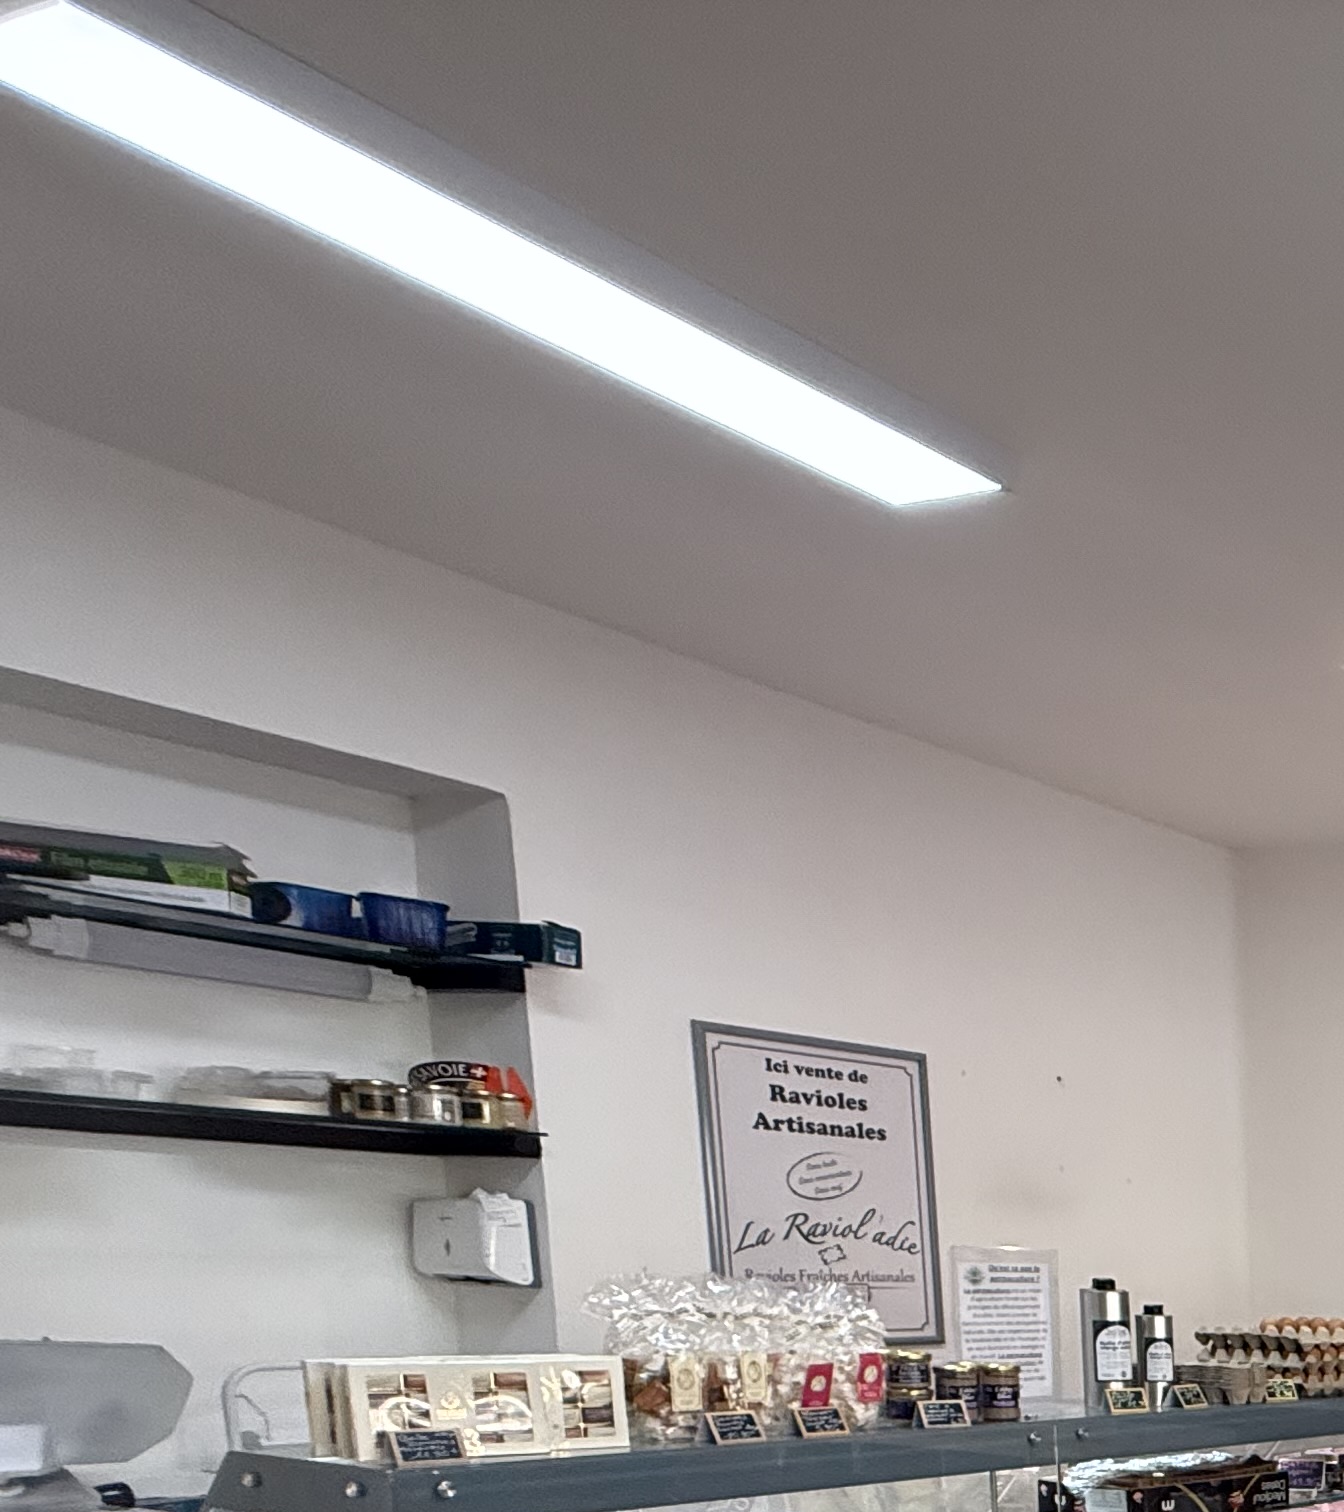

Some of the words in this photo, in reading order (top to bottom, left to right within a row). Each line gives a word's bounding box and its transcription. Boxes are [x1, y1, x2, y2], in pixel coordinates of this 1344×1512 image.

[413, 1063, 468, 1082] SAVOIE
[765, 1058, 789, 1074] Ici
[794, 1064, 844, 1081] vente
[848, 1069, 868, 1084] de
[769, 1084, 868, 1111] Ravioles
[752, 1112, 887, 1141] Artisanales
[734, 1221, 775, 1255] La
[852, 1268, 916, 1283] Artisanales
